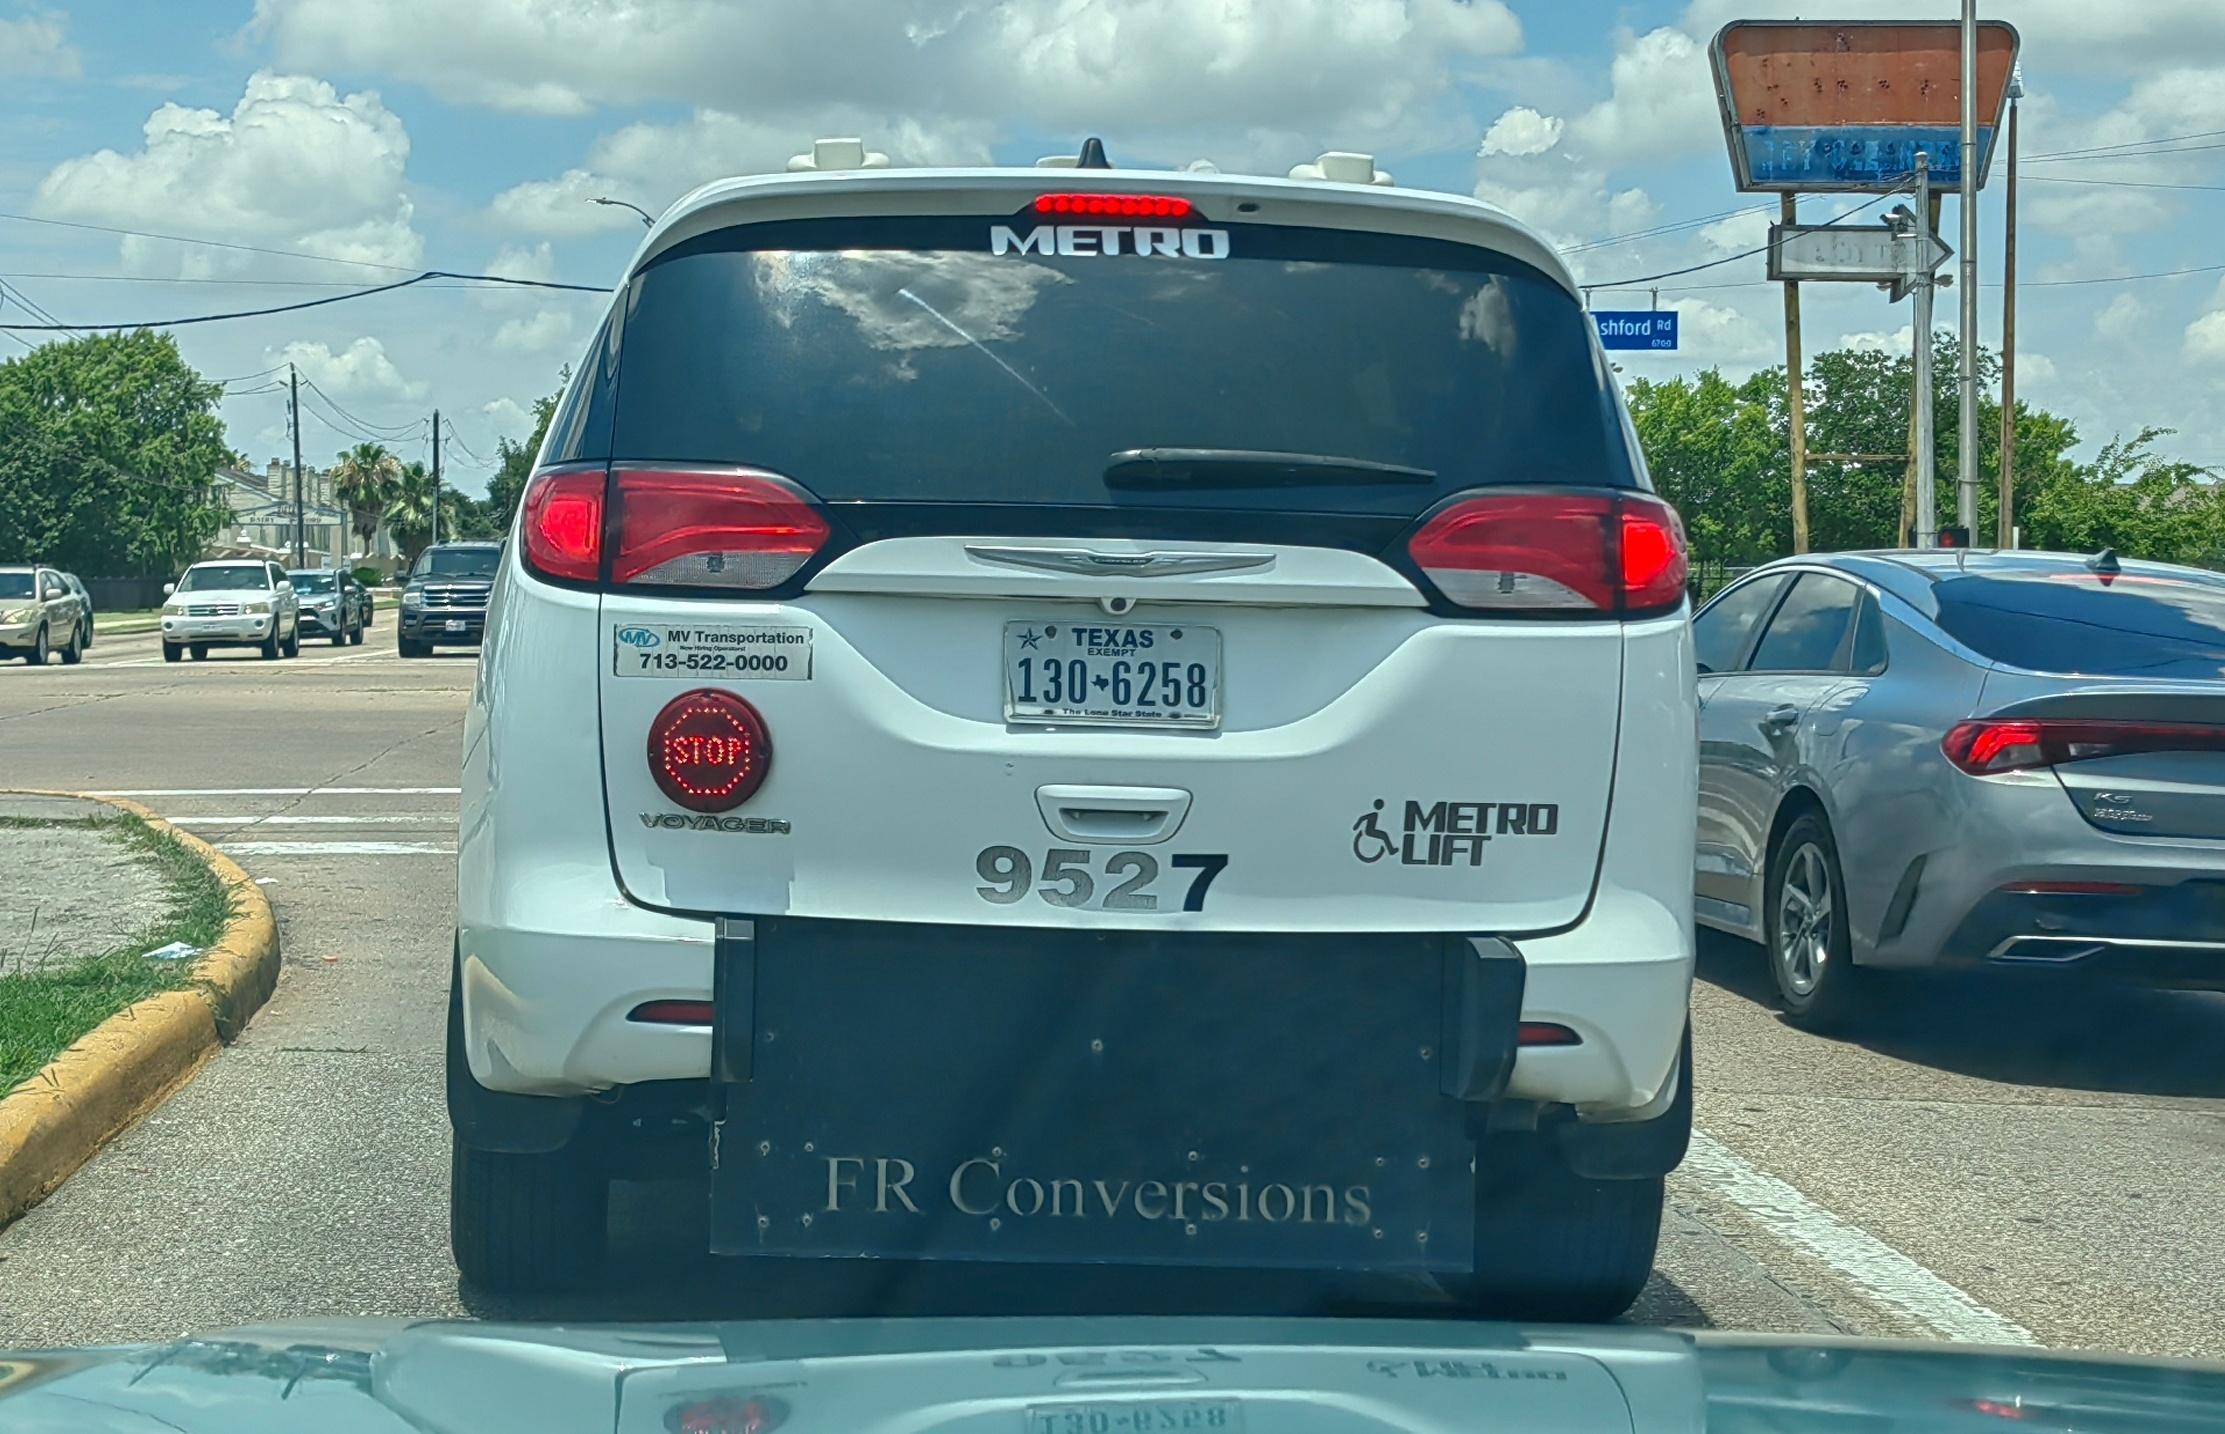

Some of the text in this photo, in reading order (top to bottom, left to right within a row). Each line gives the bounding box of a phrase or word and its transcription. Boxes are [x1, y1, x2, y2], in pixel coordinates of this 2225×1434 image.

[990, 225, 1230, 259] METRO
[1600, 319, 1672, 336] shford Rd
[1651, 339, 1672, 348] 6700
[668, 630, 805, 645] MV Transportation
[1071, 627, 1154, 649] TEXAS
[639, 653, 788, 671] 713-522-0000
[1087, 647, 1136, 657] EXEMPT
[1062, 707, 1162, 718] The Lone Star State
[672, 735, 742, 766] STOP
[638, 811, 792, 835] VOYAGER
[1402, 799, 1559, 836] METRO
[1400, 833, 1492, 868] LIFT
[975, 845, 1229, 913] 9527
[823, 1155, 1373, 1226] FR Conversions
